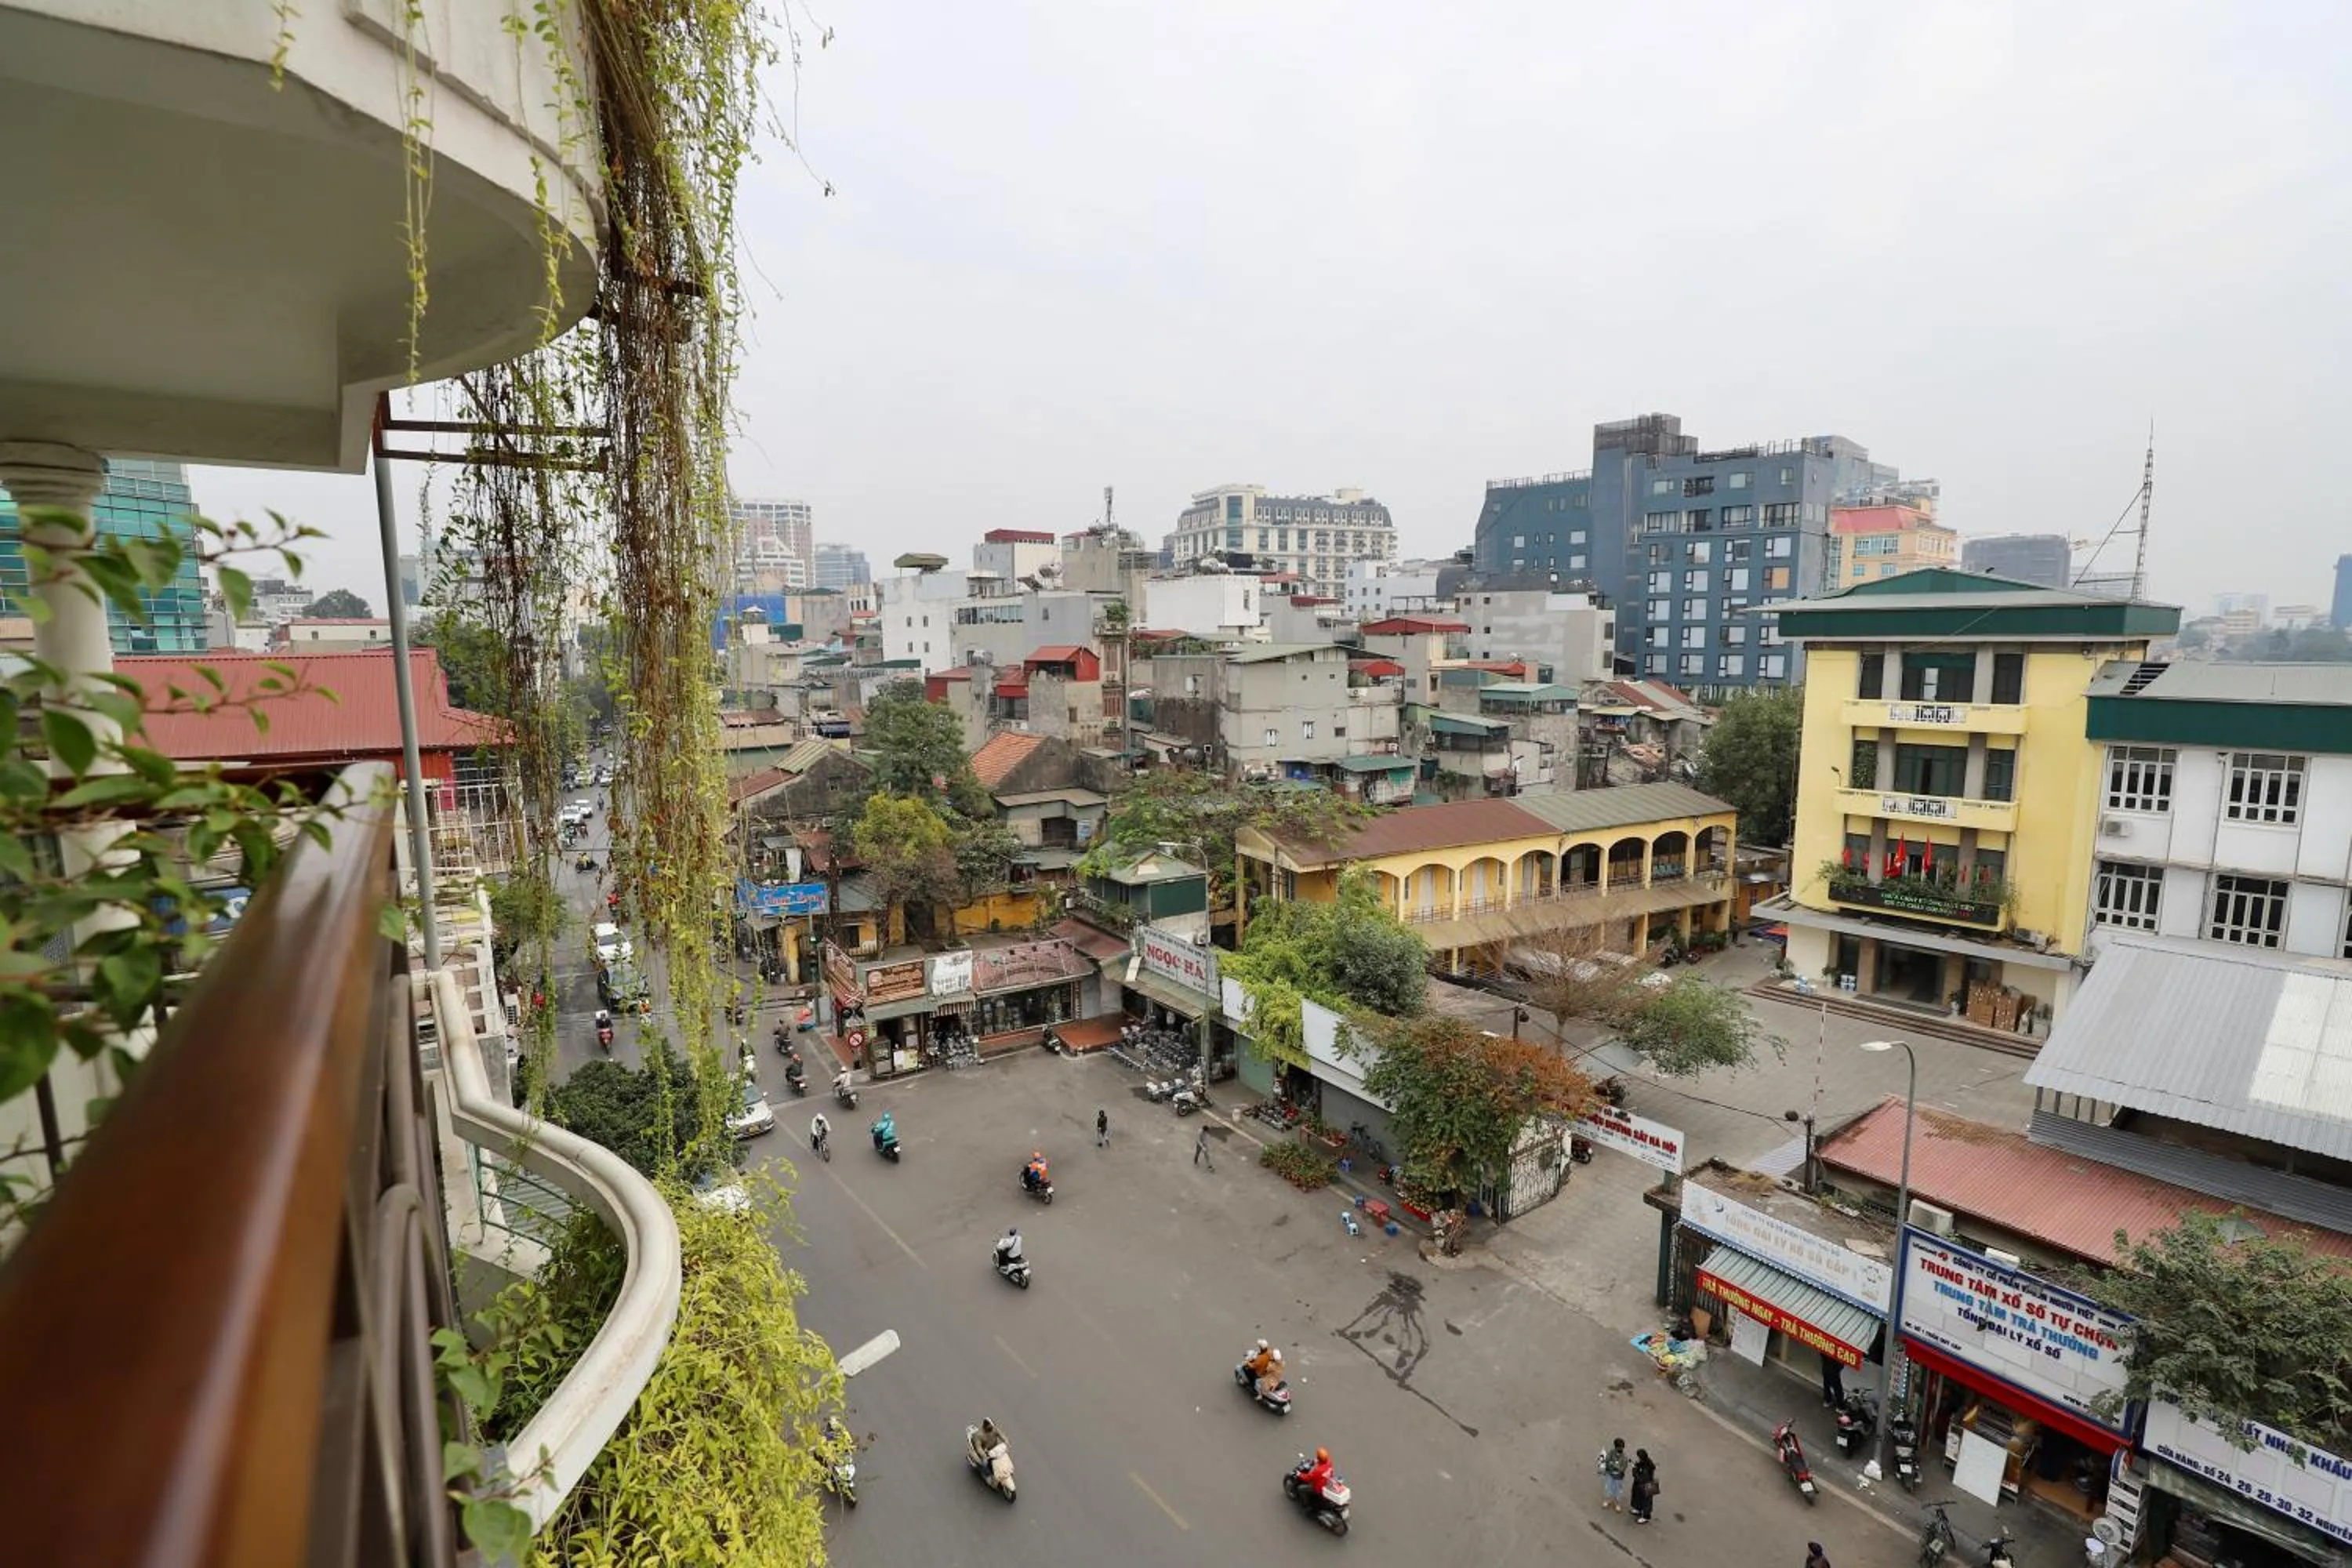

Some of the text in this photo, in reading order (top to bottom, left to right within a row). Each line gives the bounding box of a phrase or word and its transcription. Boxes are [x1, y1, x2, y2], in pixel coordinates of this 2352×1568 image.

[1145, 943, 1180, 969] NGỌC
[1920, 1258, 1964, 1286] TRUNG
[1967, 1277, 1998, 1300] TÂM
[2002, 1291, 2023, 1309] XỔ
[2026, 1301, 2047, 1319] SỐ
[2050, 1312, 2071, 1331] TỰ
[1933, 1280, 2100, 1361] TRUNG TÂM TRẢ THƯỞNG
[1751, 1302, 1774, 1323] NGAY
[1780, 1316, 1798, 1335] TRẢ
[1837, 1348, 1857, 1366] CAO
[1987, 1320, 2007, 1338] ĐẠI
[2009, 1330, 2024, 1344] LÝ
[2045, 1345, 2062, 1360] SỐ
[2157, 1444, 2174, 1458] CỬA
[2217, 1470, 2231, 1484] 24
[2237, 1479, 2252, 1494] 26
[2257, 1489, 2273, 1504] 28
[2277, 1497, 2292, 1512] 30
[2298, 1507, 2314, 1523] 32
